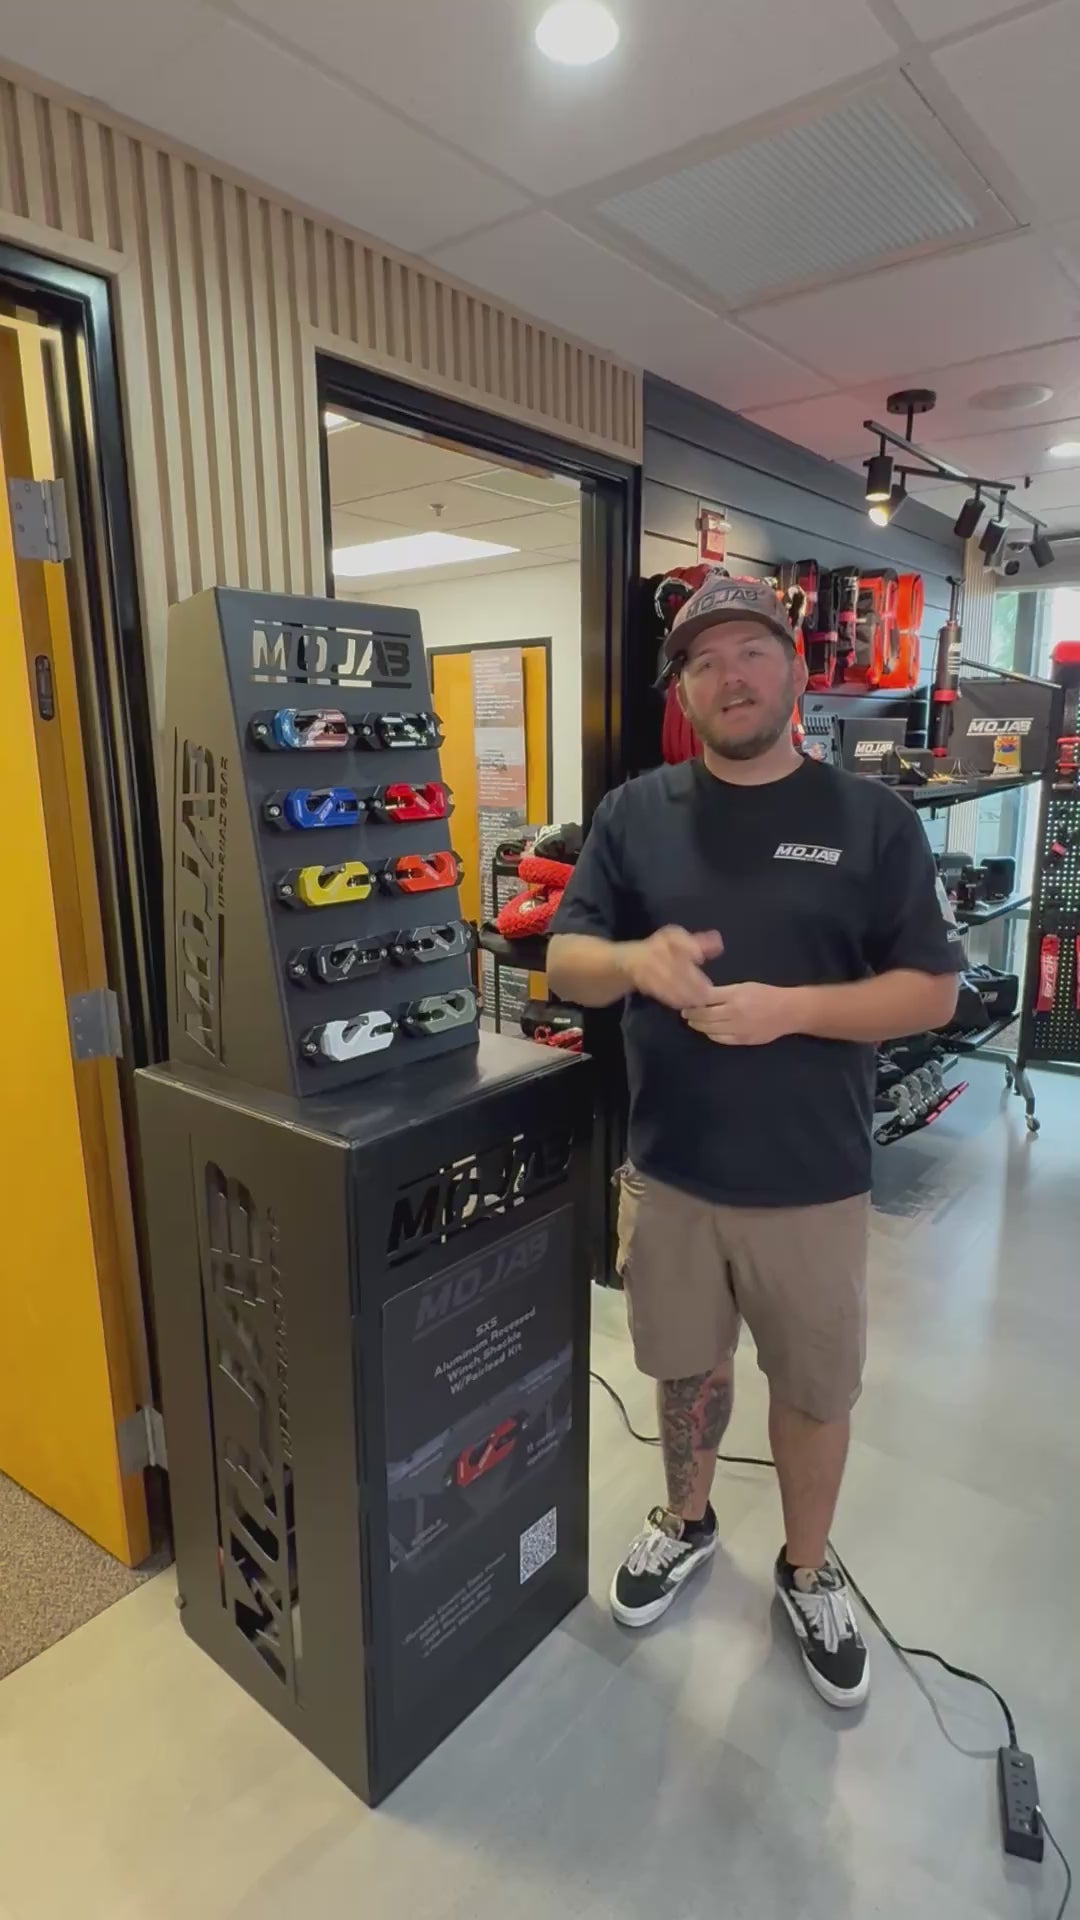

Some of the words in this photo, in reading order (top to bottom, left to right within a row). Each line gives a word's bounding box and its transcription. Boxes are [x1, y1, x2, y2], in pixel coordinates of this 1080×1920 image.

[686, 588, 758, 618] MOJAB
[252, 630, 410, 677] MOJAB
[967, 720, 1032, 733] MOJAB
[219, 756, 229, 809] GEAR
[775, 845, 841, 864] MOJAB
[415, 1229, 549, 1331] MOJAB
[434, 1338, 489, 1378] Aluminum
[490, 1305, 537, 1342] Recessed
[447, 1356, 481, 1382] Winch
[483, 1330, 522, 1361] Shackle
[507, 1343, 523, 1358] Kit
